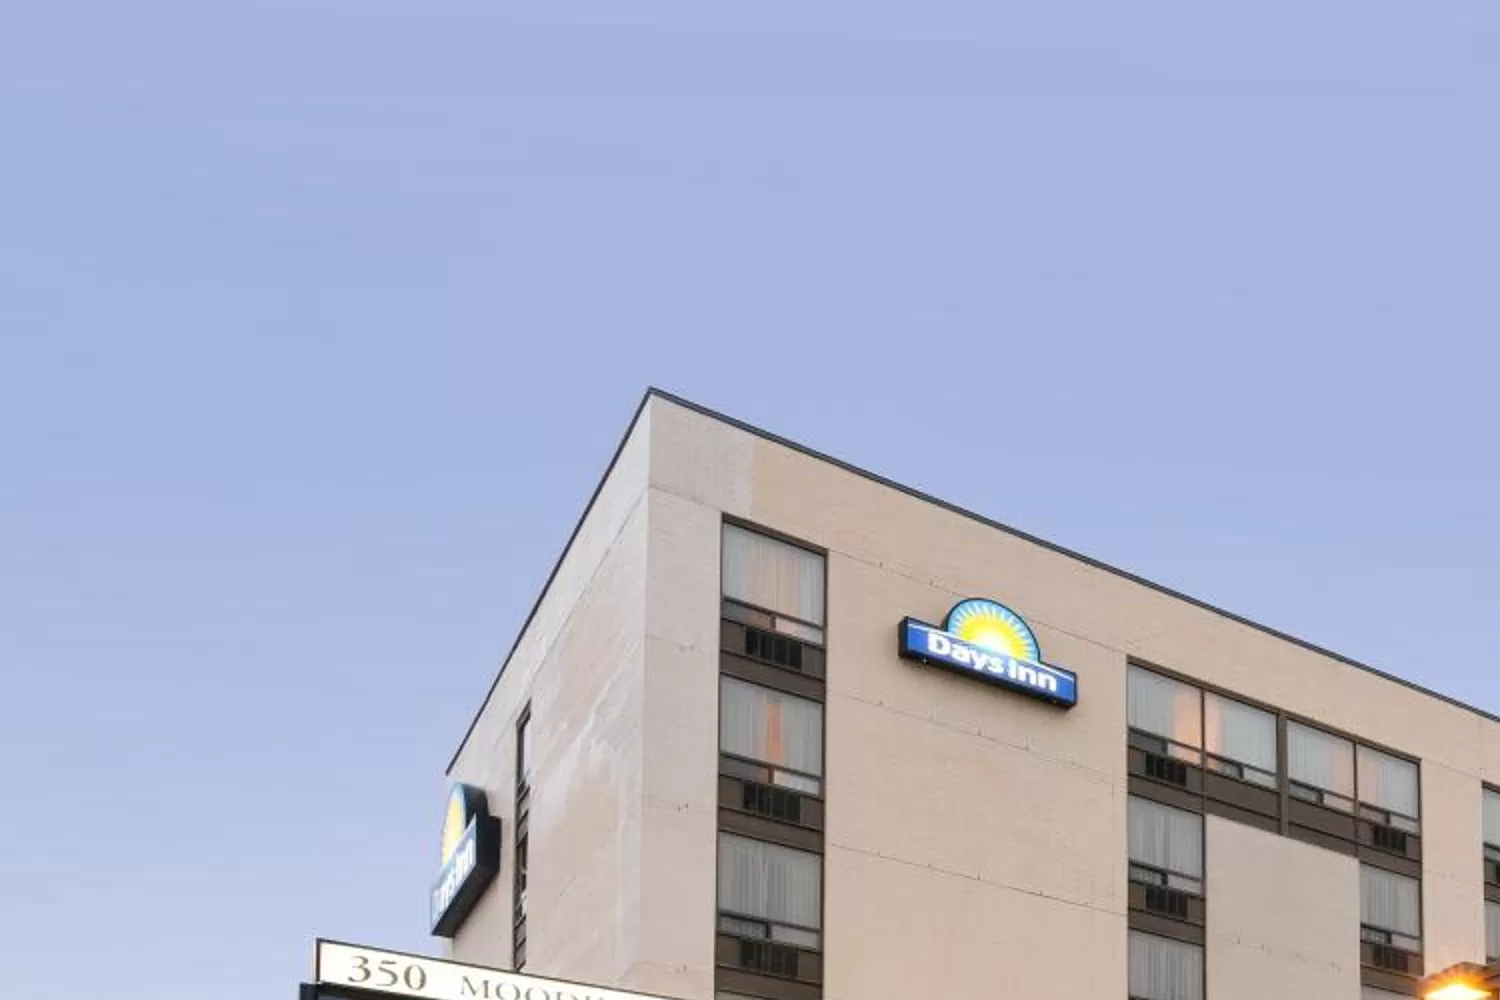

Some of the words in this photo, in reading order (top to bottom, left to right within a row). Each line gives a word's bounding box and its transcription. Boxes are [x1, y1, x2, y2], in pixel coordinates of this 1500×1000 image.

[928, 632, 1005, 674] Days
[1007, 657, 1057, 692] Inn
[348, 955, 426, 991] 350
